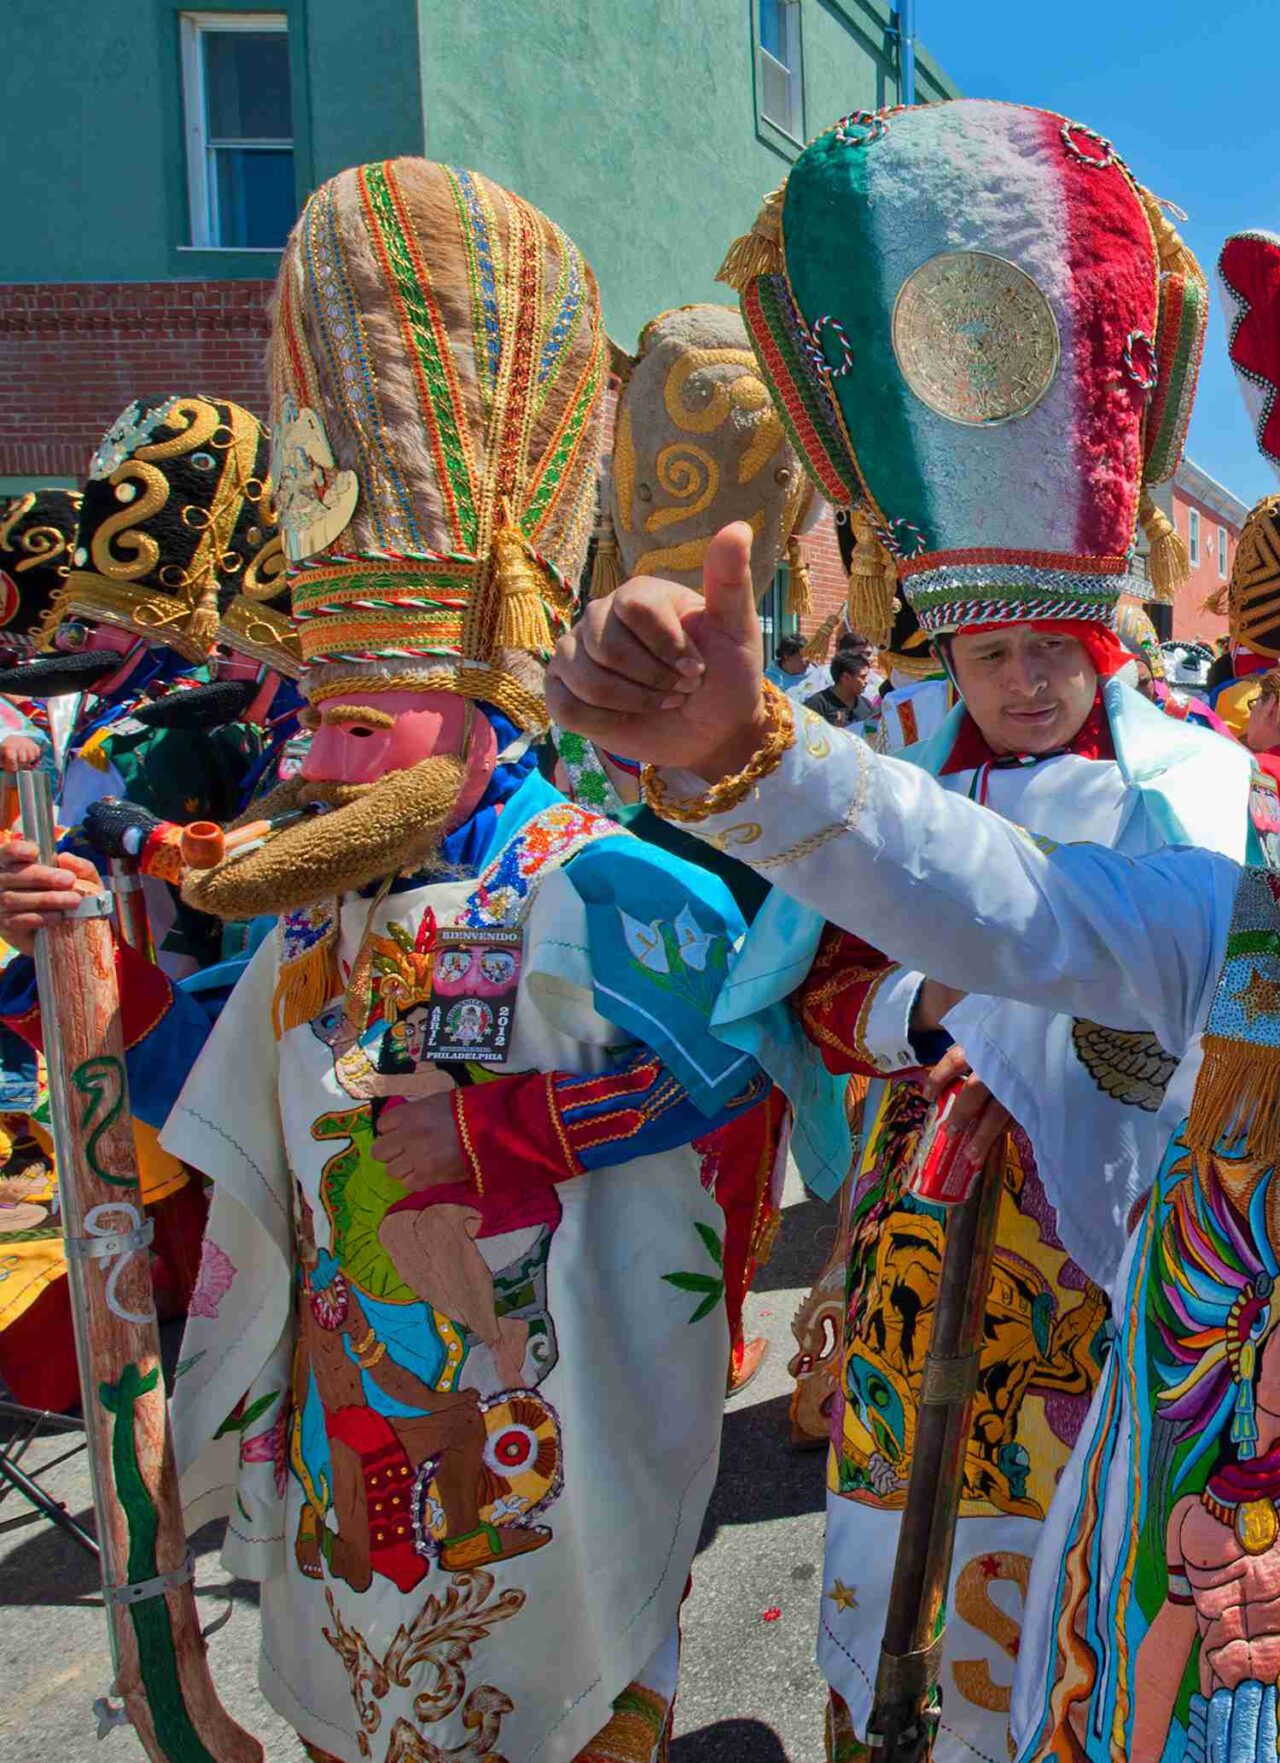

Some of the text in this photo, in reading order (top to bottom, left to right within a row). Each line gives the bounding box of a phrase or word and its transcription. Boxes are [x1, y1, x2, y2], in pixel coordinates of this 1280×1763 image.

[442, 931, 517, 941] BIENVENIDO
[427, 1006, 441, 1046] ABRIL
[495, 1006, 510, 1046] 2012
[426, 1052, 503, 1061] PHILADELPHIA
